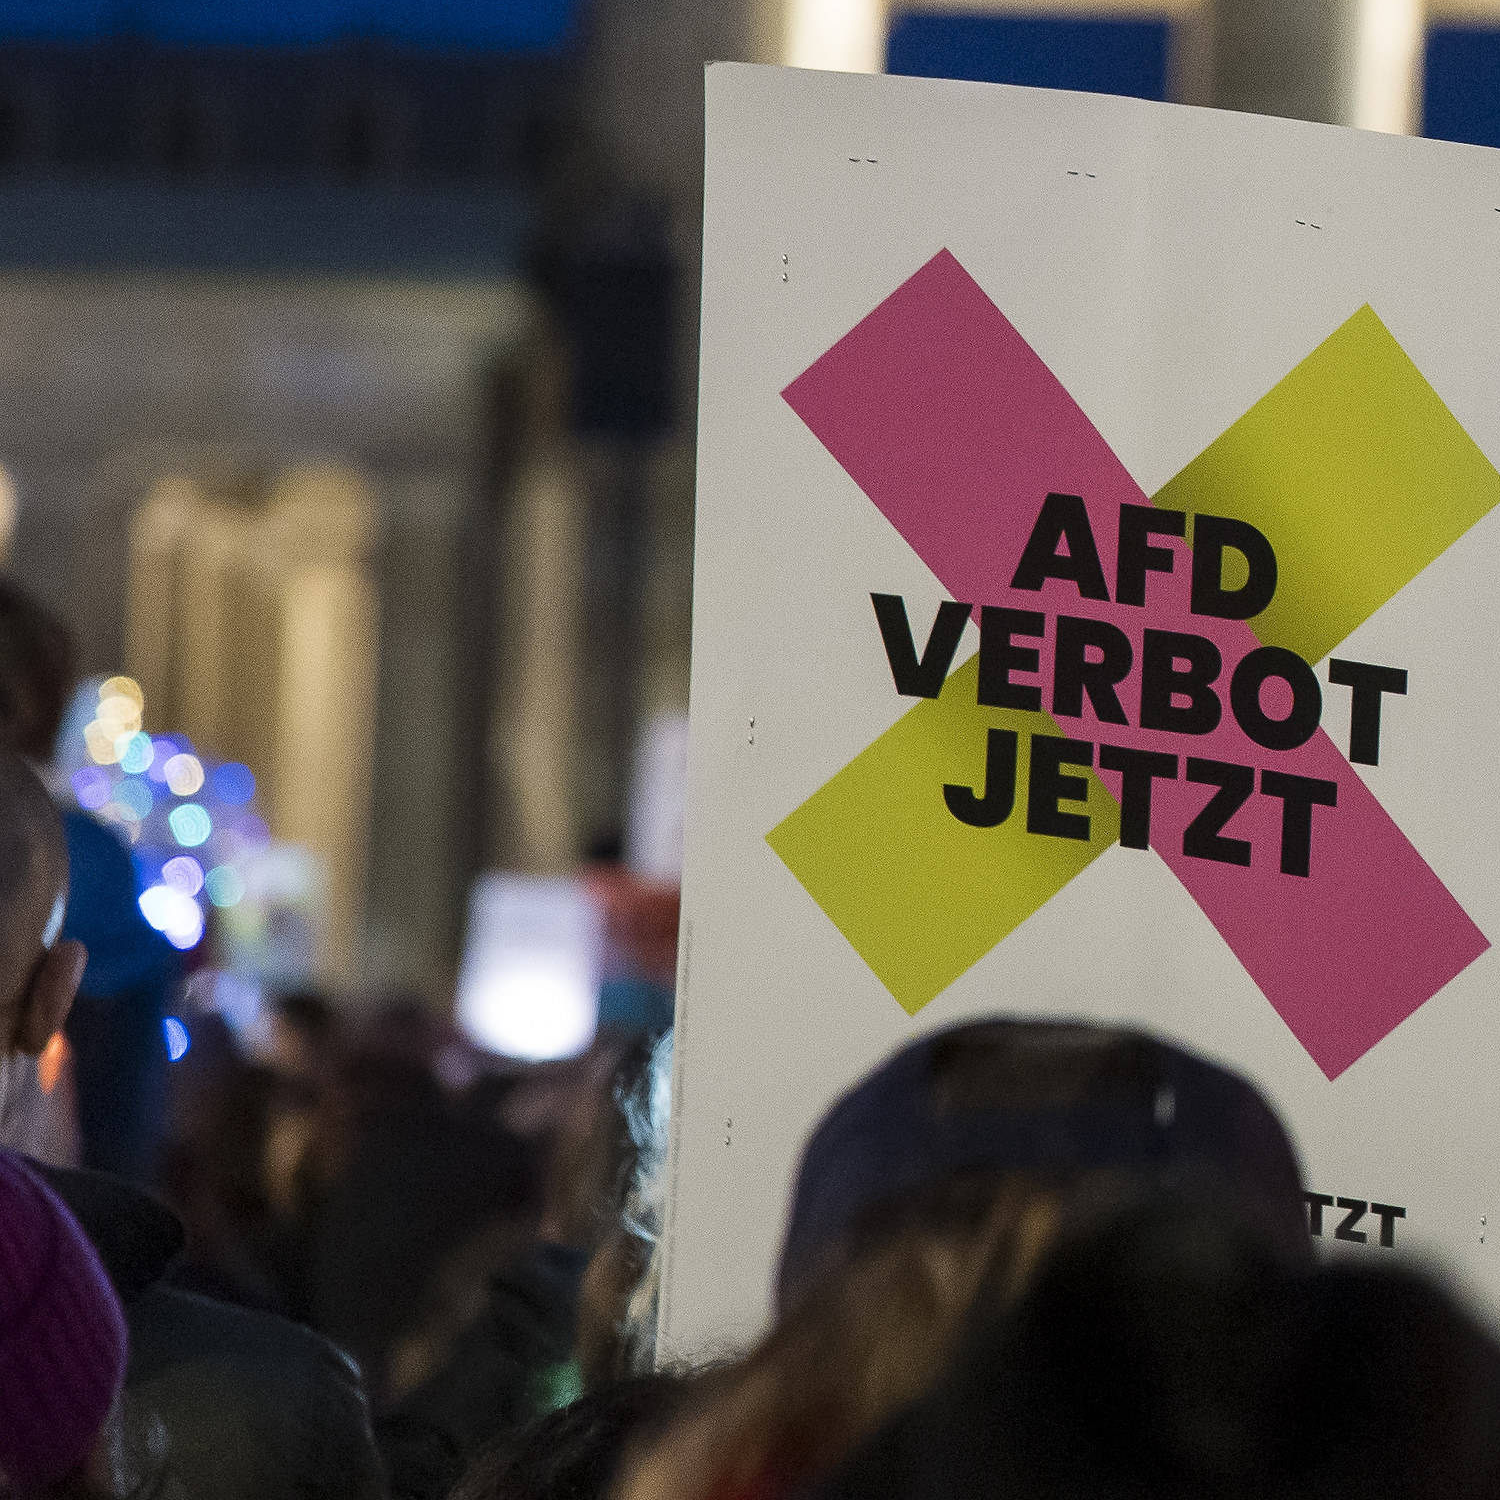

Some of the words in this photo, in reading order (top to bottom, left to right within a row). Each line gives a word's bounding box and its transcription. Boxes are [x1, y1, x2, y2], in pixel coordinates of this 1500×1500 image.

[1009, 492, 1278, 621] AFD
[869, 592, 1408, 767] VERBOT
[942, 728, 1338, 878] JETZT
